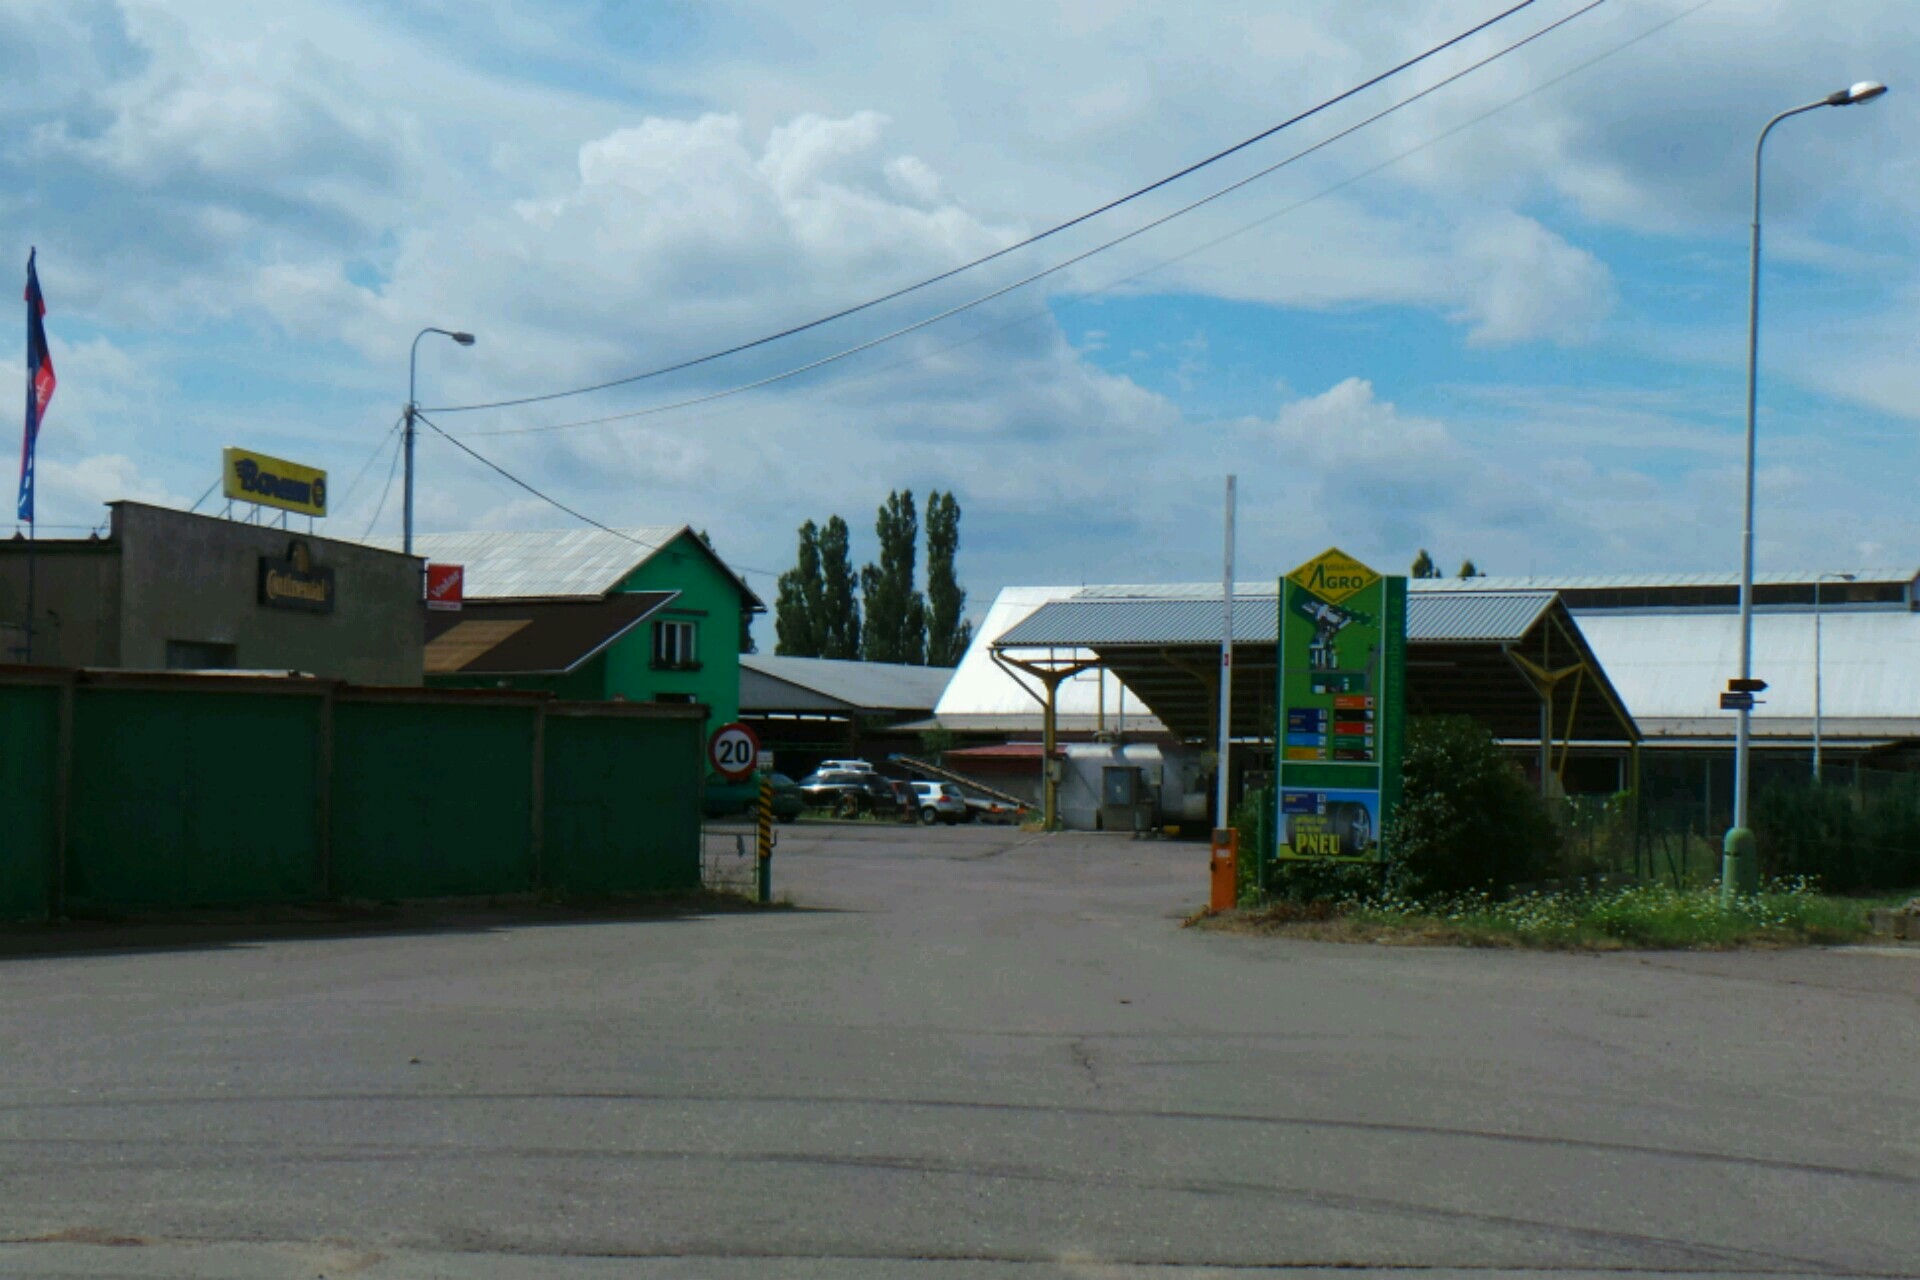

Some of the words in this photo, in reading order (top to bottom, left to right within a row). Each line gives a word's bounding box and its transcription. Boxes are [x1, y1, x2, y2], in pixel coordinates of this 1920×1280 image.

[1308, 563, 1363, 589] AGRO
[719, 740, 749, 763] 20
[1295, 833, 1341, 855] PNEU
